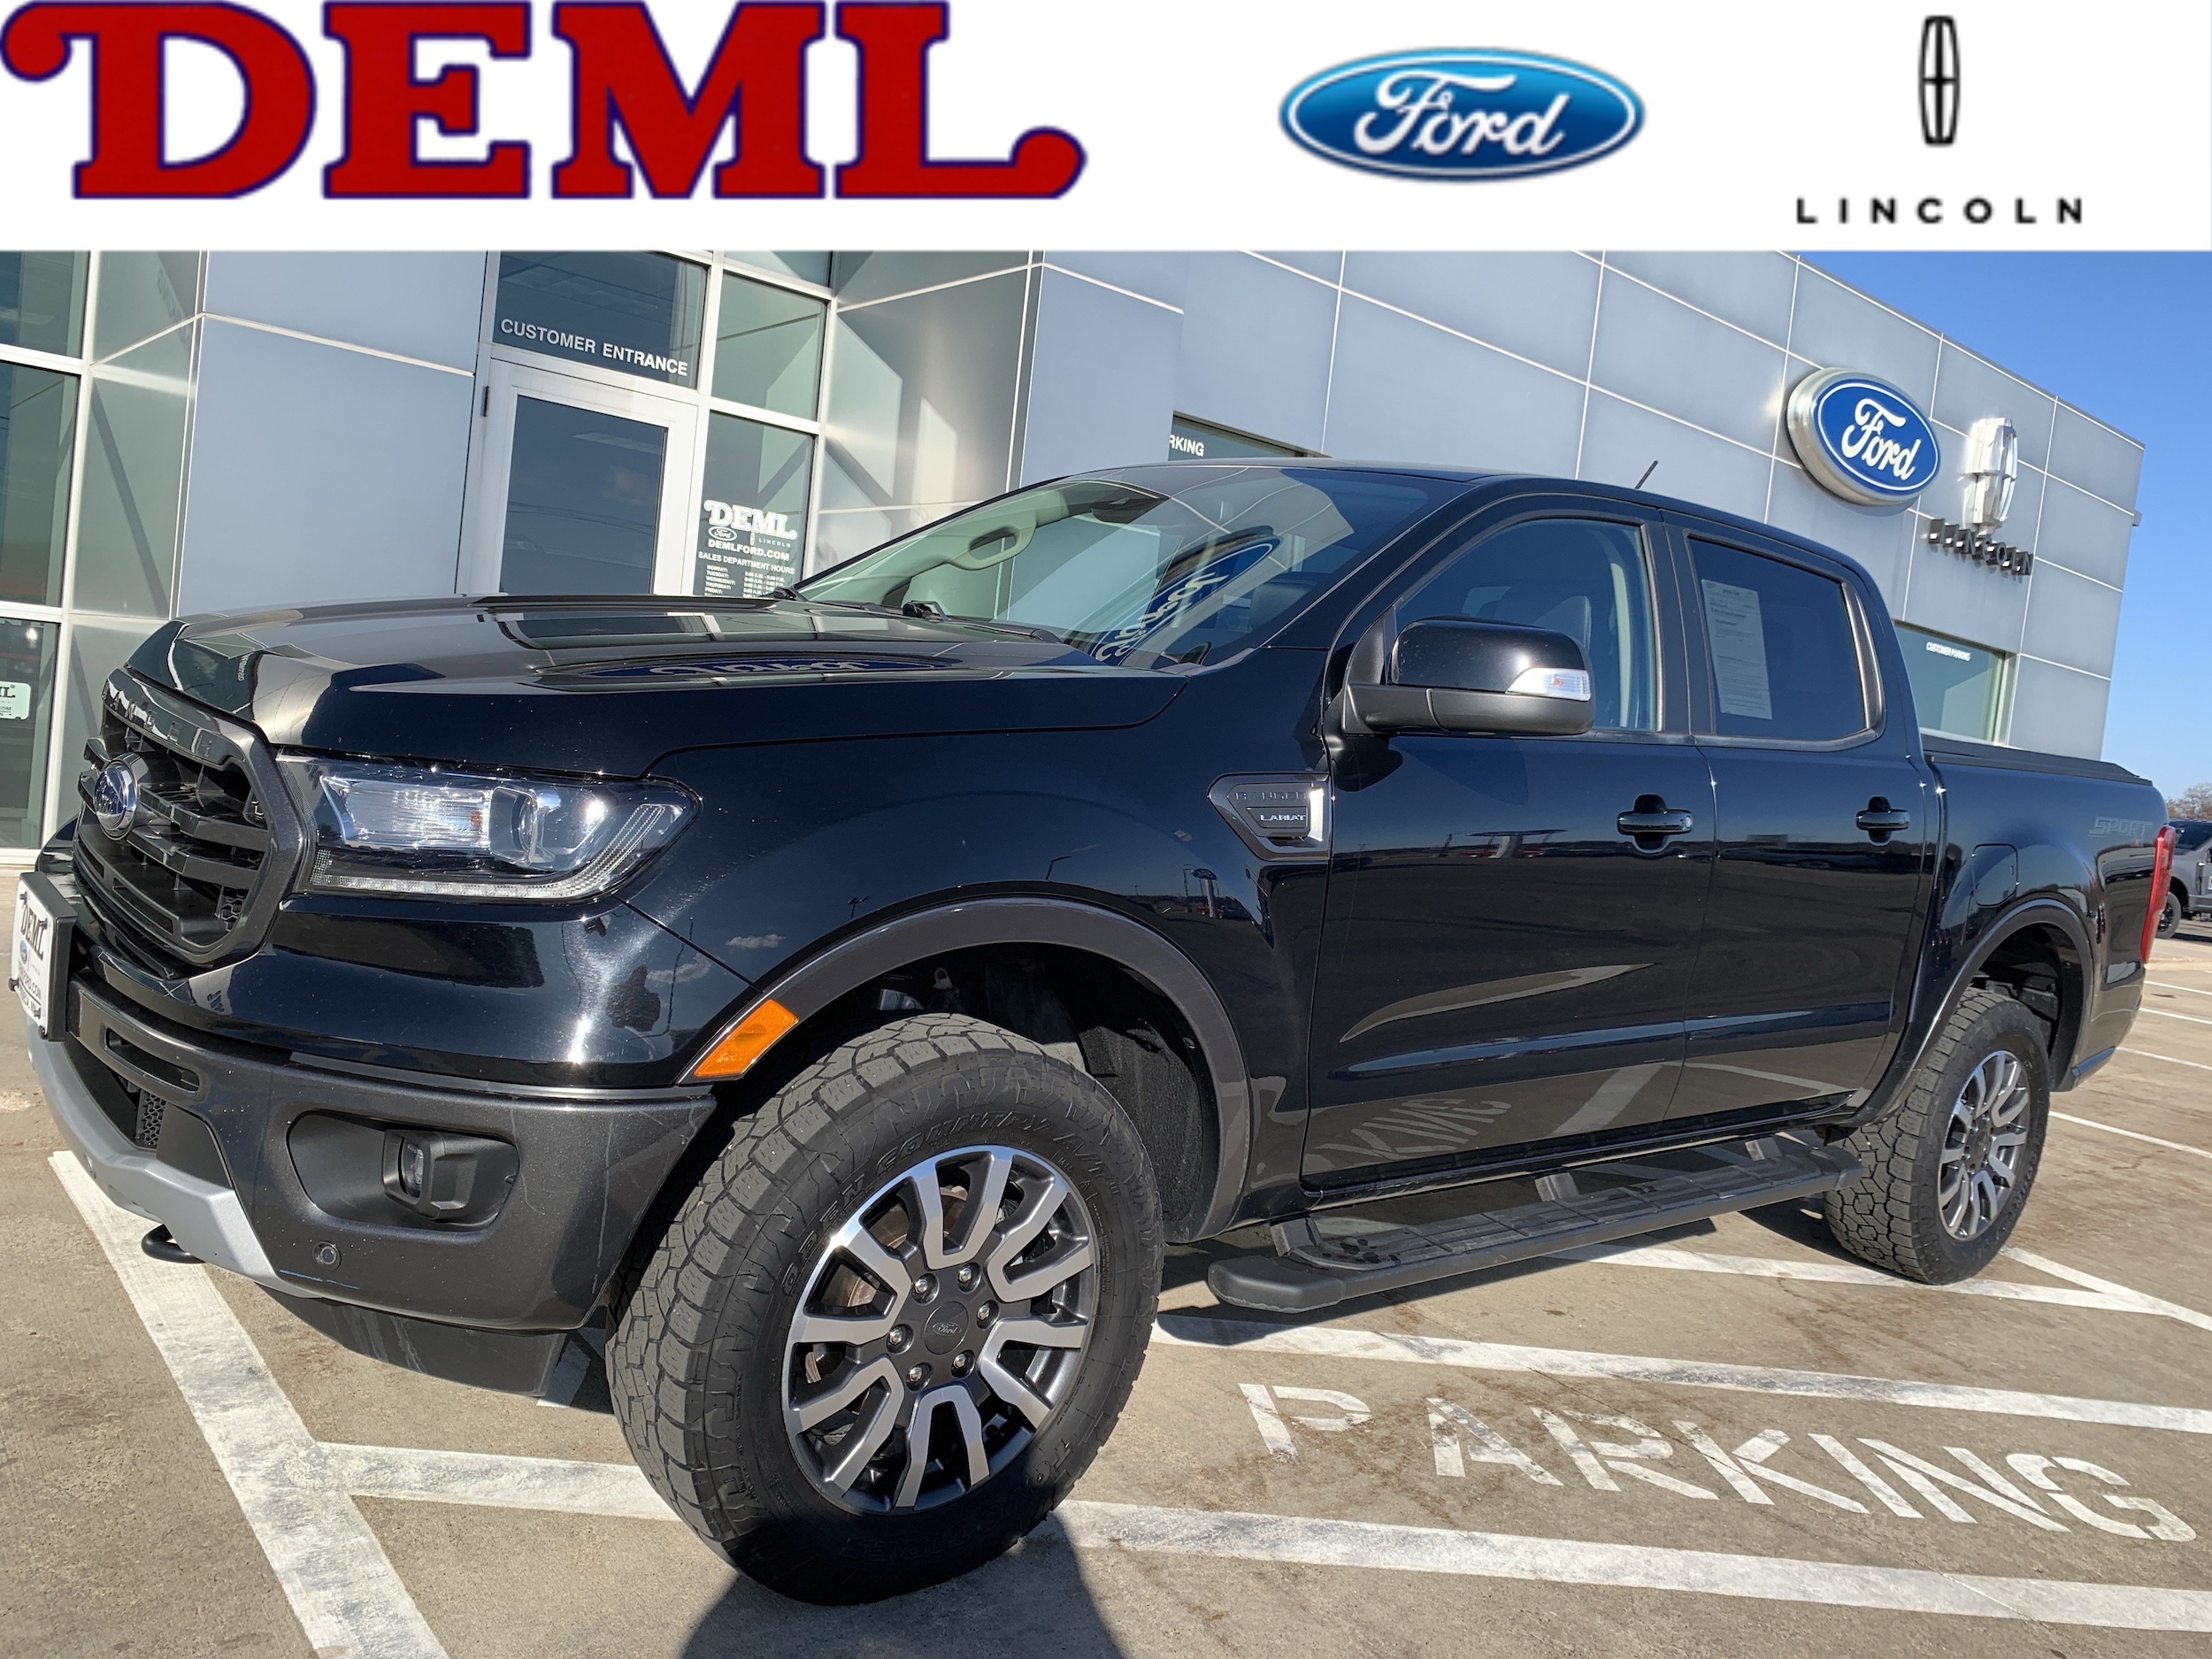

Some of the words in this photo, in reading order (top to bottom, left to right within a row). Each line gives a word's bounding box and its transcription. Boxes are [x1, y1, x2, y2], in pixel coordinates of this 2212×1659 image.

[501, 319, 595, 354] CUSTOMER
[603, 342, 688, 376] ENTRANCE
[1841, 397, 1922, 480] Ford
[703, 500, 798, 541] DEML
[714, 528, 733, 538] Ford
[708, 538, 790, 562] DEMLFORD.COM
[758, 538, 791, 548] LINCOLN
[698, 550, 722, 563] SALES
[723, 556, 771, 571] DEPARTMENT
[771, 564, 795, 575] HOURS
[2088, 816, 2154, 838] SPORT
[1238, 1382, 2197, 1543] PARKING
